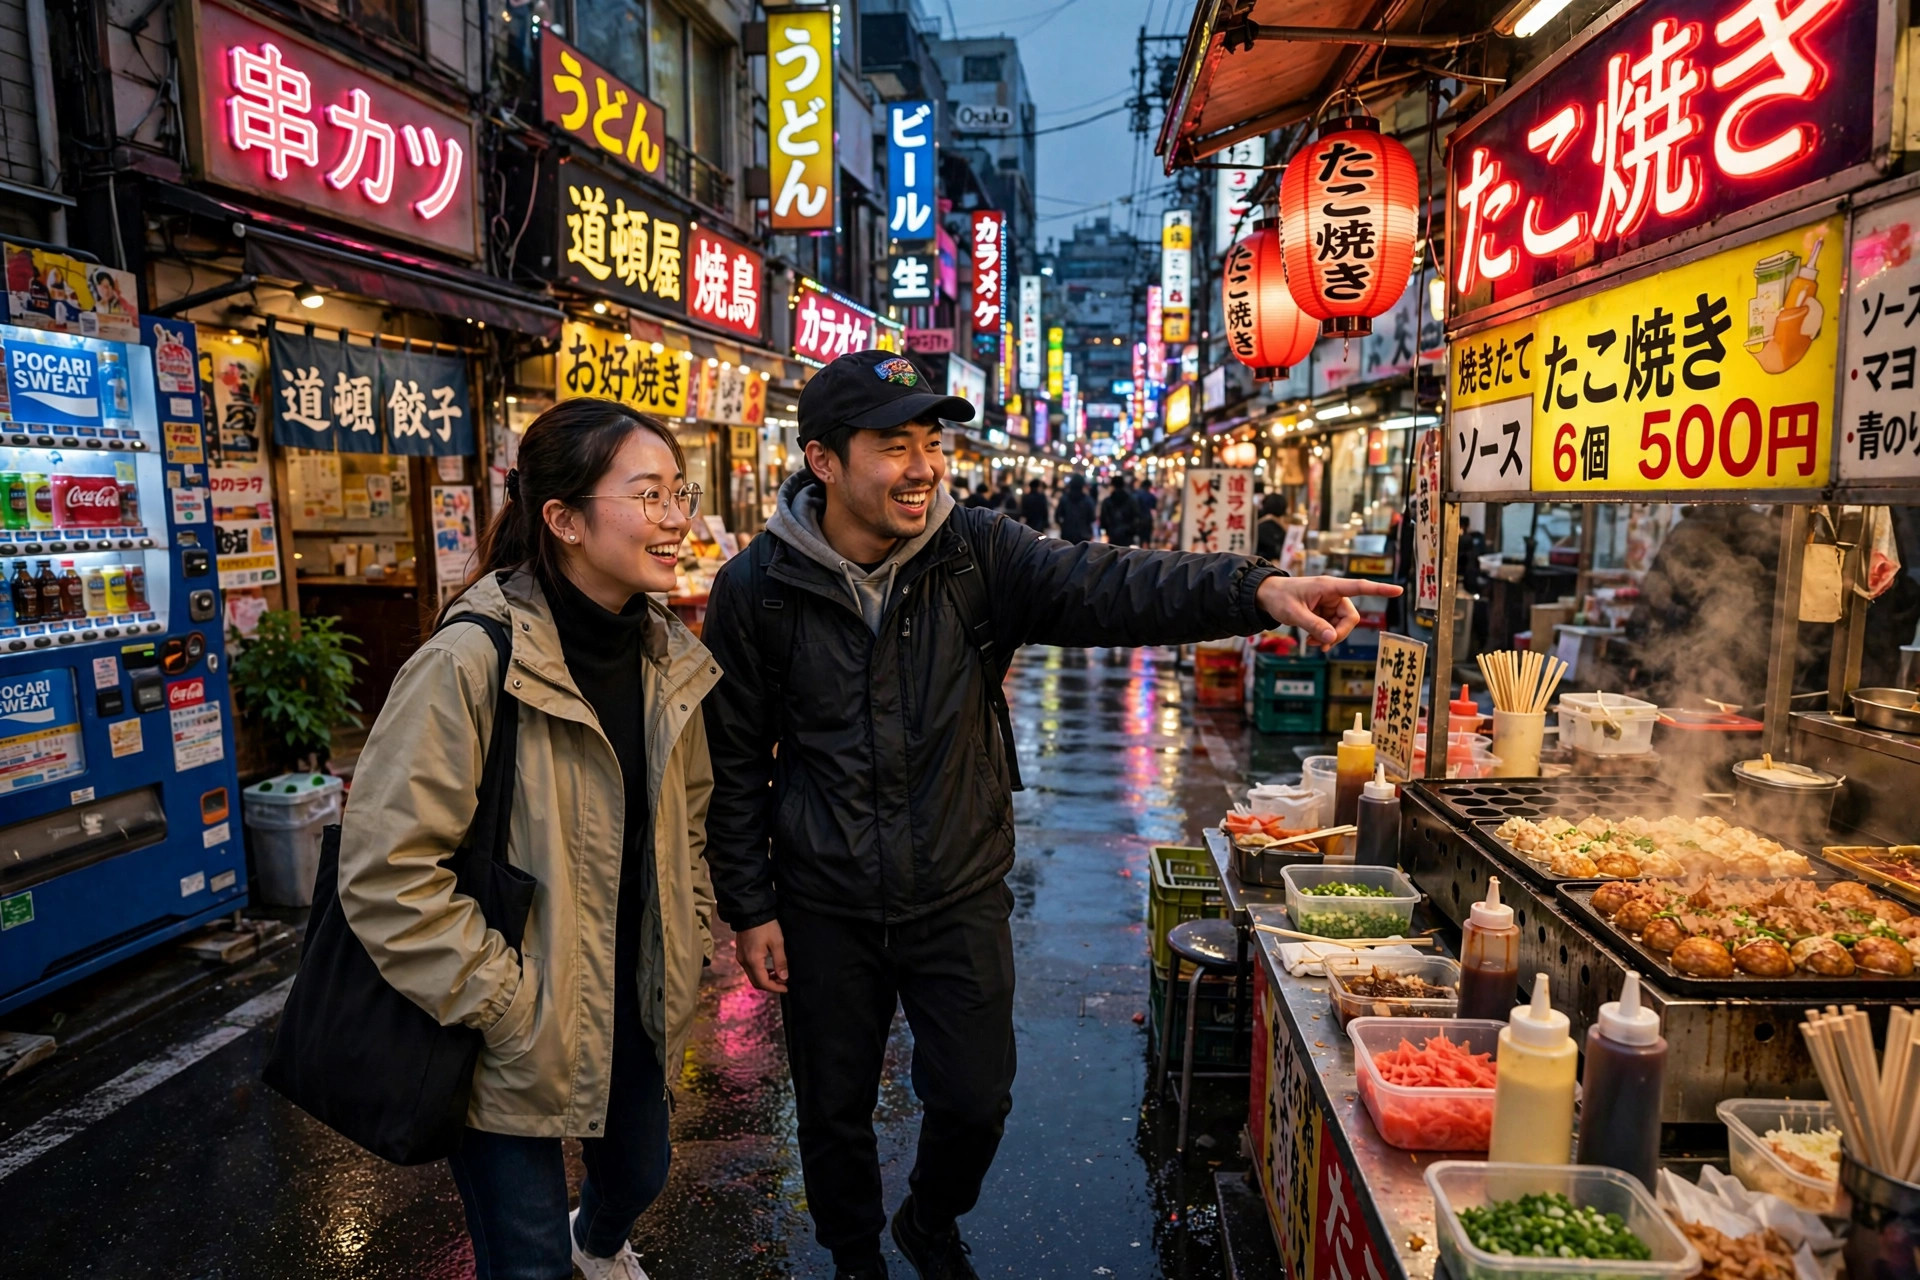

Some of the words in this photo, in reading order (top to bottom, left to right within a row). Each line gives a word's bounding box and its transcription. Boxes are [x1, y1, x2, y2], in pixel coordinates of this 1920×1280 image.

[228, 43, 463, 219] 串カツ
[553, 50, 660, 173] うどん
[774, 28, 827, 219] うどん
[1457, 0, 1839, 294] たこ焼き
[890, 104, 931, 232] ビール
[566, 185, 681, 302] 道頓屋
[1316, 142, 1376, 301] たこ焼き
[694, 239, 758, 331] 焼鳥
[892, 258, 931, 300] 生
[1227, 244, 1254, 356] たこ焼き
[12, 350, 92, 377] POCARI
[566, 333, 681, 407] お好焼き
[800, 296, 867, 357] カラオケ
[1457, 333, 1535, 397] 焼きたて
[1542, 292, 1733, 413] たこ焼き
[13, 369, 90, 396] SWEAT
[1459, 419, 1523, 480] ソース
[1552, 422, 1610, 483] 6個
[1638, 397, 1819, 481] 500円
[0, 679, 51, 700] OCARI
